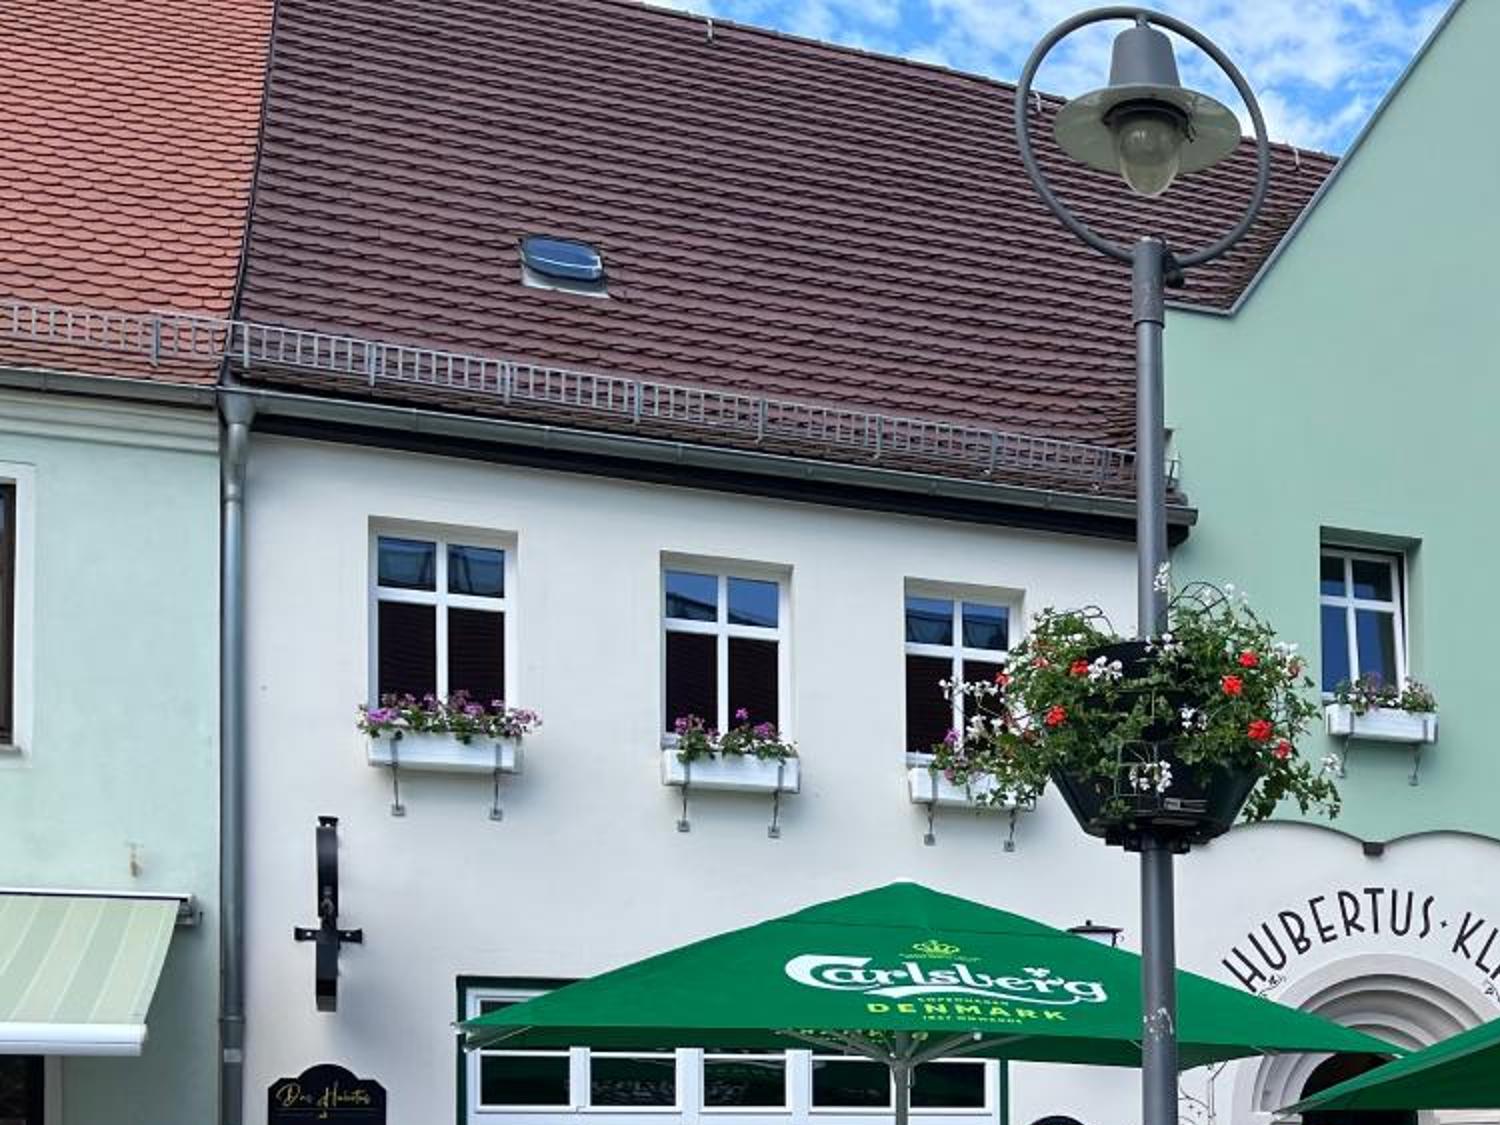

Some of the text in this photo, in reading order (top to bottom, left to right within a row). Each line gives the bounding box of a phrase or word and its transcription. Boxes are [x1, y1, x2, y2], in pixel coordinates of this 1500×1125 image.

[1221, 887, 1435, 994] HUBERTUS
[785, 953, 1108, 1005] Carlsberg
[867, 1003, 1067, 1021] DENMARK
